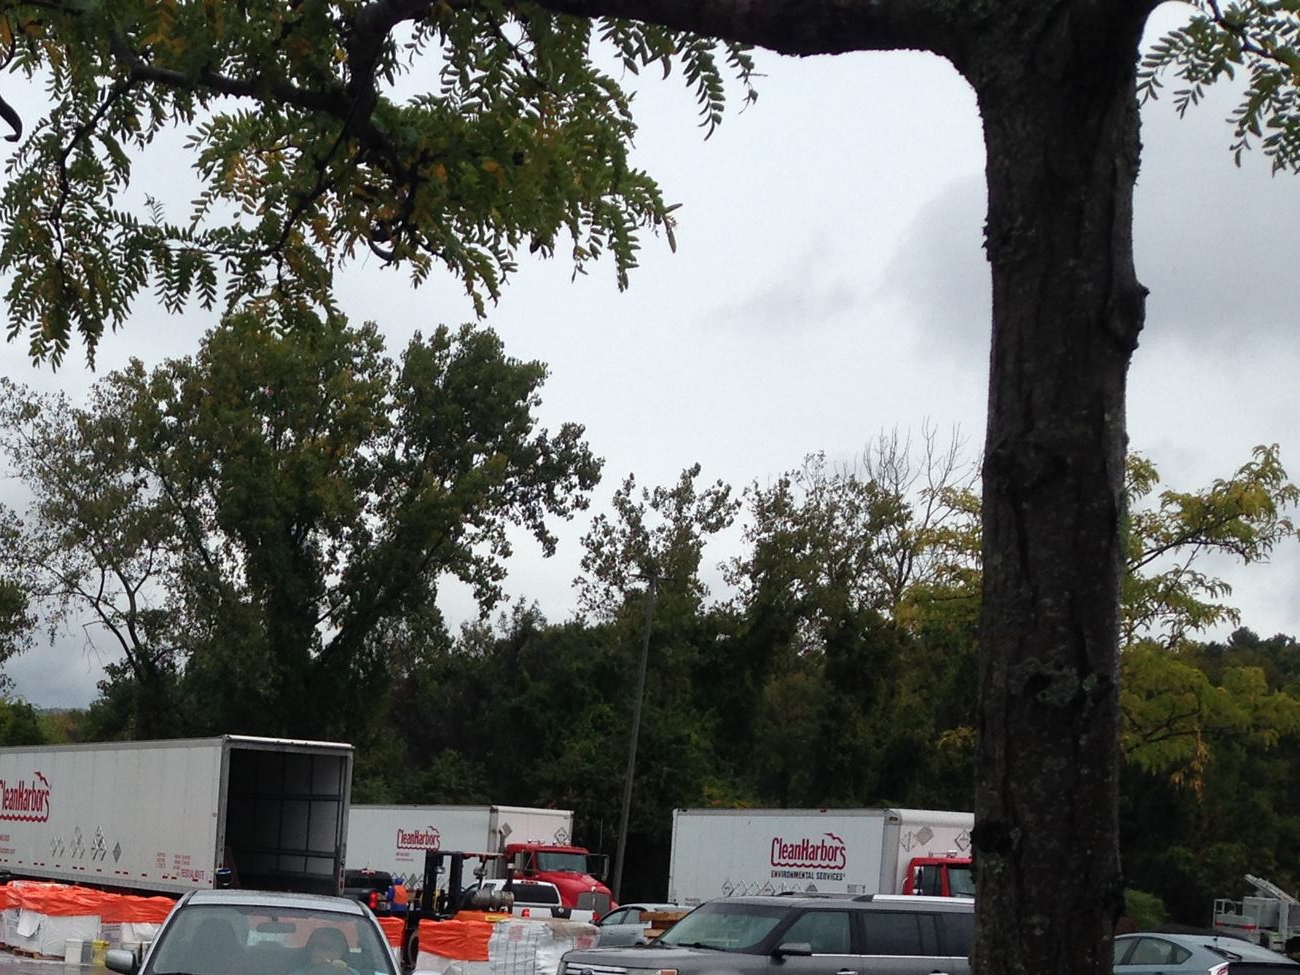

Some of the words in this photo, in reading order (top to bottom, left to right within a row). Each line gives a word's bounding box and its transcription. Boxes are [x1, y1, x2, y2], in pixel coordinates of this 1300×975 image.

[397, 828, 441, 852] CleanHarbors
[771, 837, 846, 870] CleanHarbors
[771, 869, 814, 880] ENVIRONMENTAL
